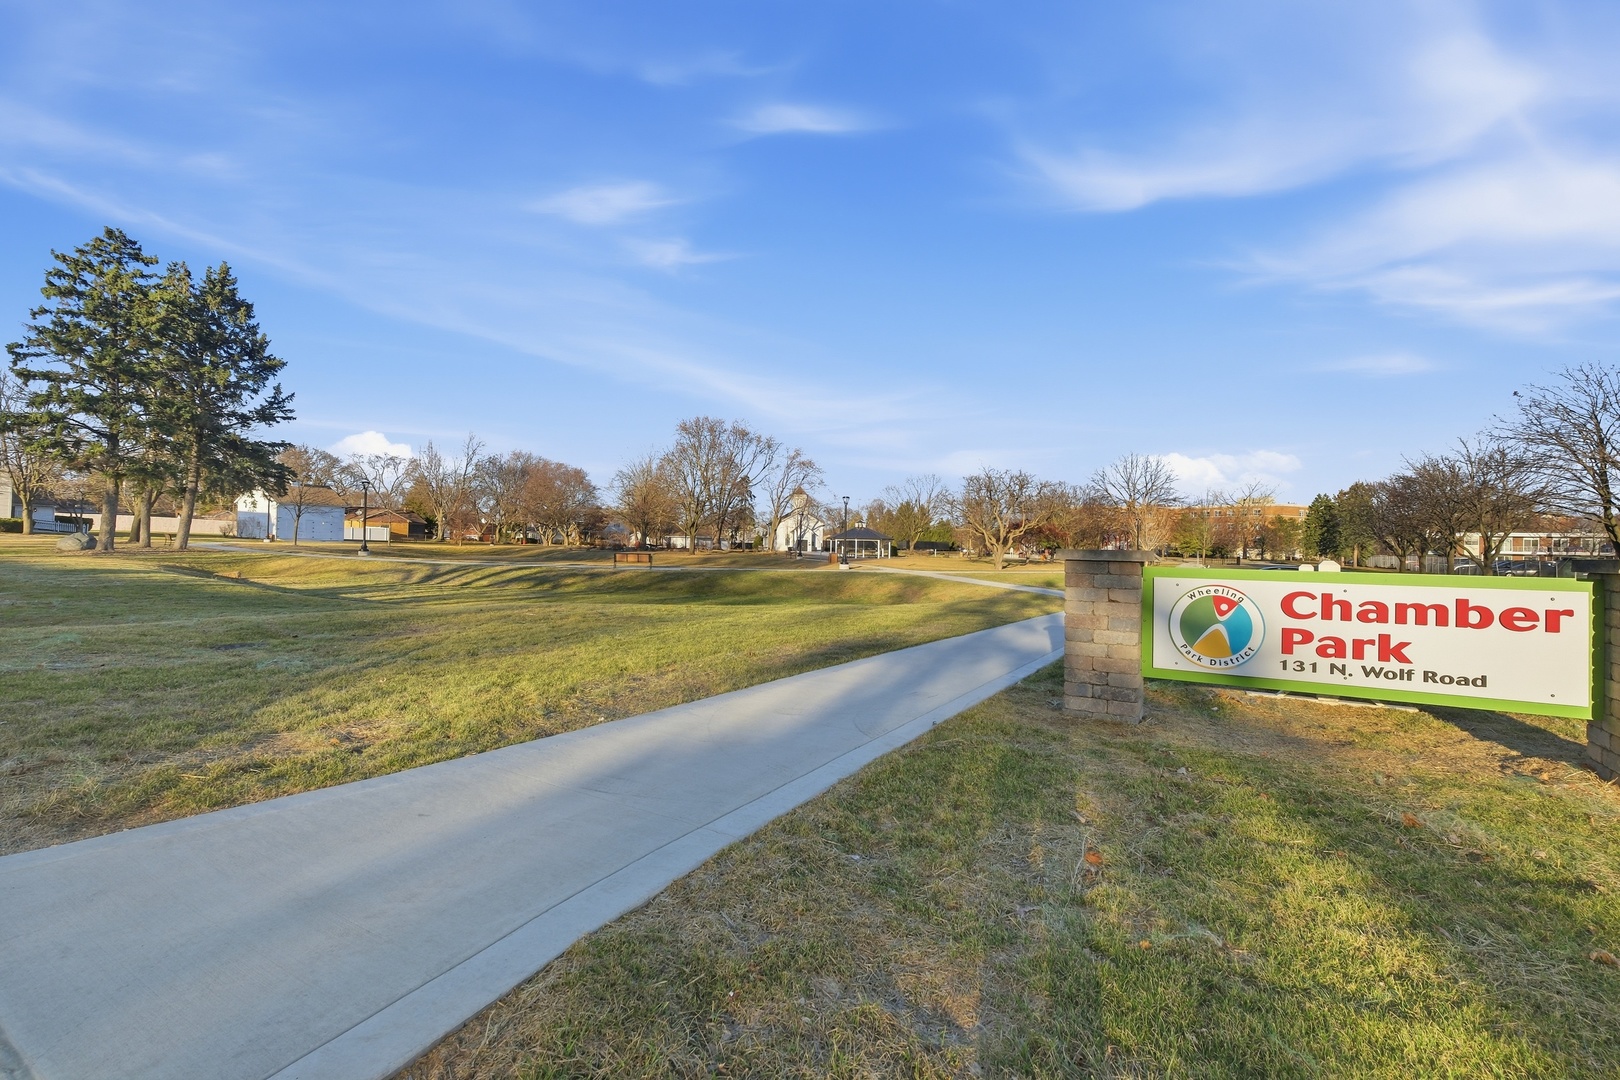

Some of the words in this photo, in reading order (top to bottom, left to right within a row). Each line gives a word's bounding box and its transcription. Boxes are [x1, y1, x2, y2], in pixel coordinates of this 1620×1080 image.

[1187, 588, 1245, 604] Wheeling
[1280, 591, 1574, 633] Chamber
[1180, 643, 1203, 663] Park
[1209, 646, 1255, 666] District
[1280, 627, 1413, 664] Park
[1279, 659, 1318, 674] 131
[1329, 662, 1353, 677] N.
[1361, 665, 1415, 682] Wolf
[1423, 670, 1488, 688] Road
